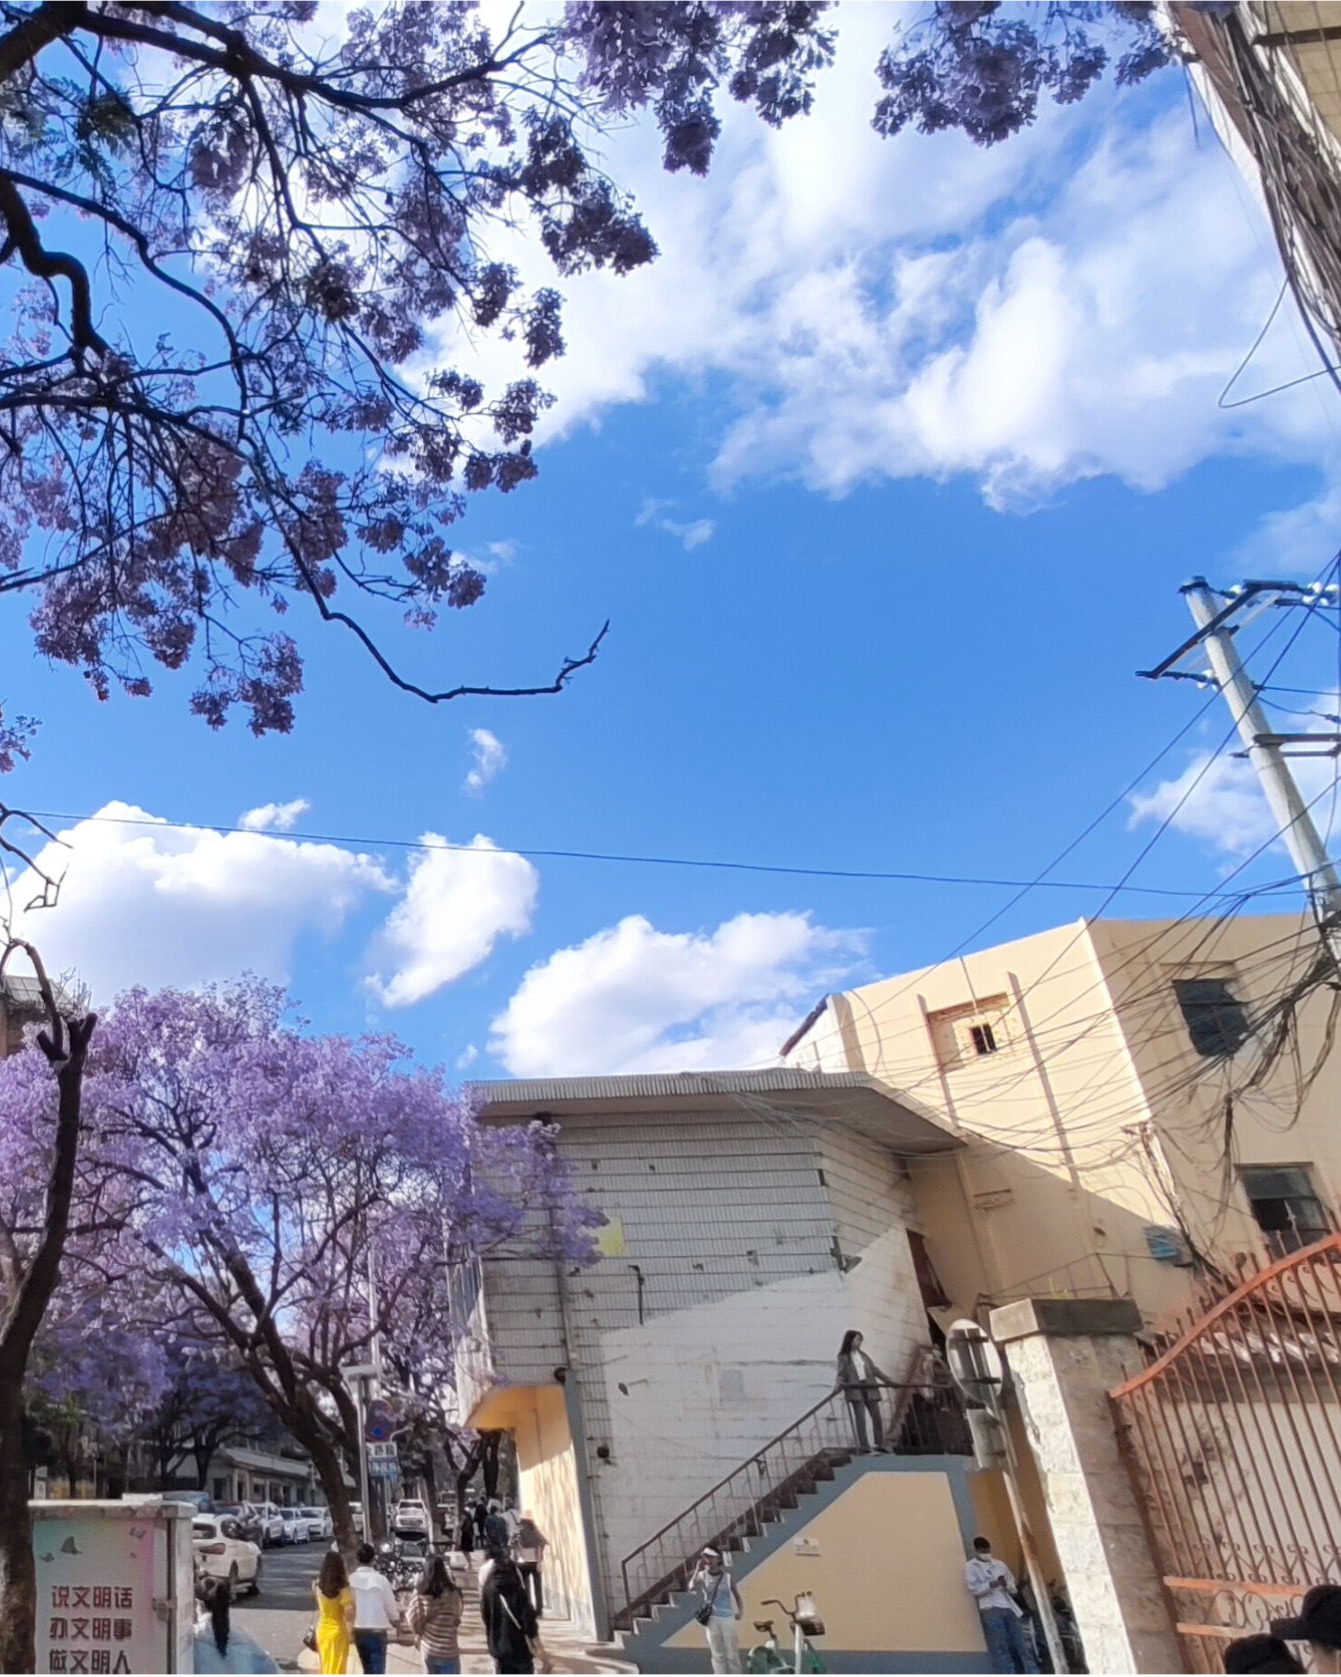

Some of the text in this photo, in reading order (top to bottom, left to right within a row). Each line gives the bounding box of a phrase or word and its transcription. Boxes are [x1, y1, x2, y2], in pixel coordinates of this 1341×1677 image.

[52, 1586, 133, 1609] 说文明话
[49, 1617, 133, 1640] 办文明事
[49, 1649, 132, 1674] 做文明人
